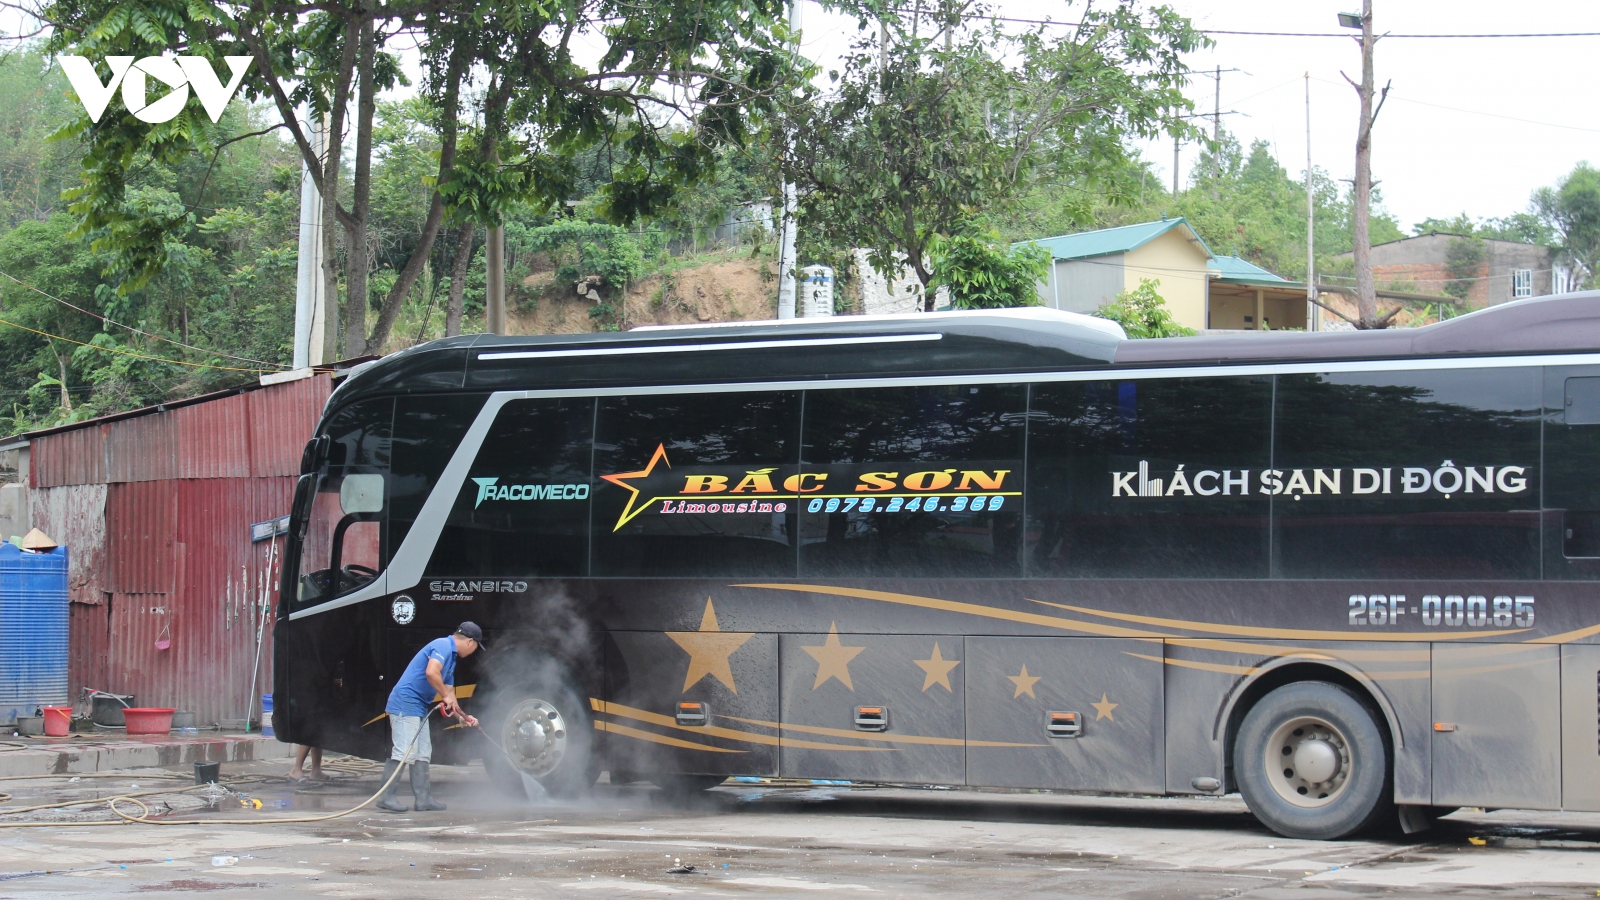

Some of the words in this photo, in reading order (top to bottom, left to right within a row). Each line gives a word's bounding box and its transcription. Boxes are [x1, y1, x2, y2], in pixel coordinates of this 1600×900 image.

[679, 467, 828, 493] BẮC
[855, 468, 1011, 491] SƠN
[1259, 469, 1342, 501] SẠN
[1352, 467, 1392, 494] DI
[1401, 459, 1527, 499] ĐỘNG
[470, 477, 590, 510] TRACOMECO
[660, 500, 787, 514] Limousine
[807, 496, 1005, 513] 0973.246.369
[429, 580, 528, 593] GRANBIRD
[431, 594, 474, 602] Sunshine
